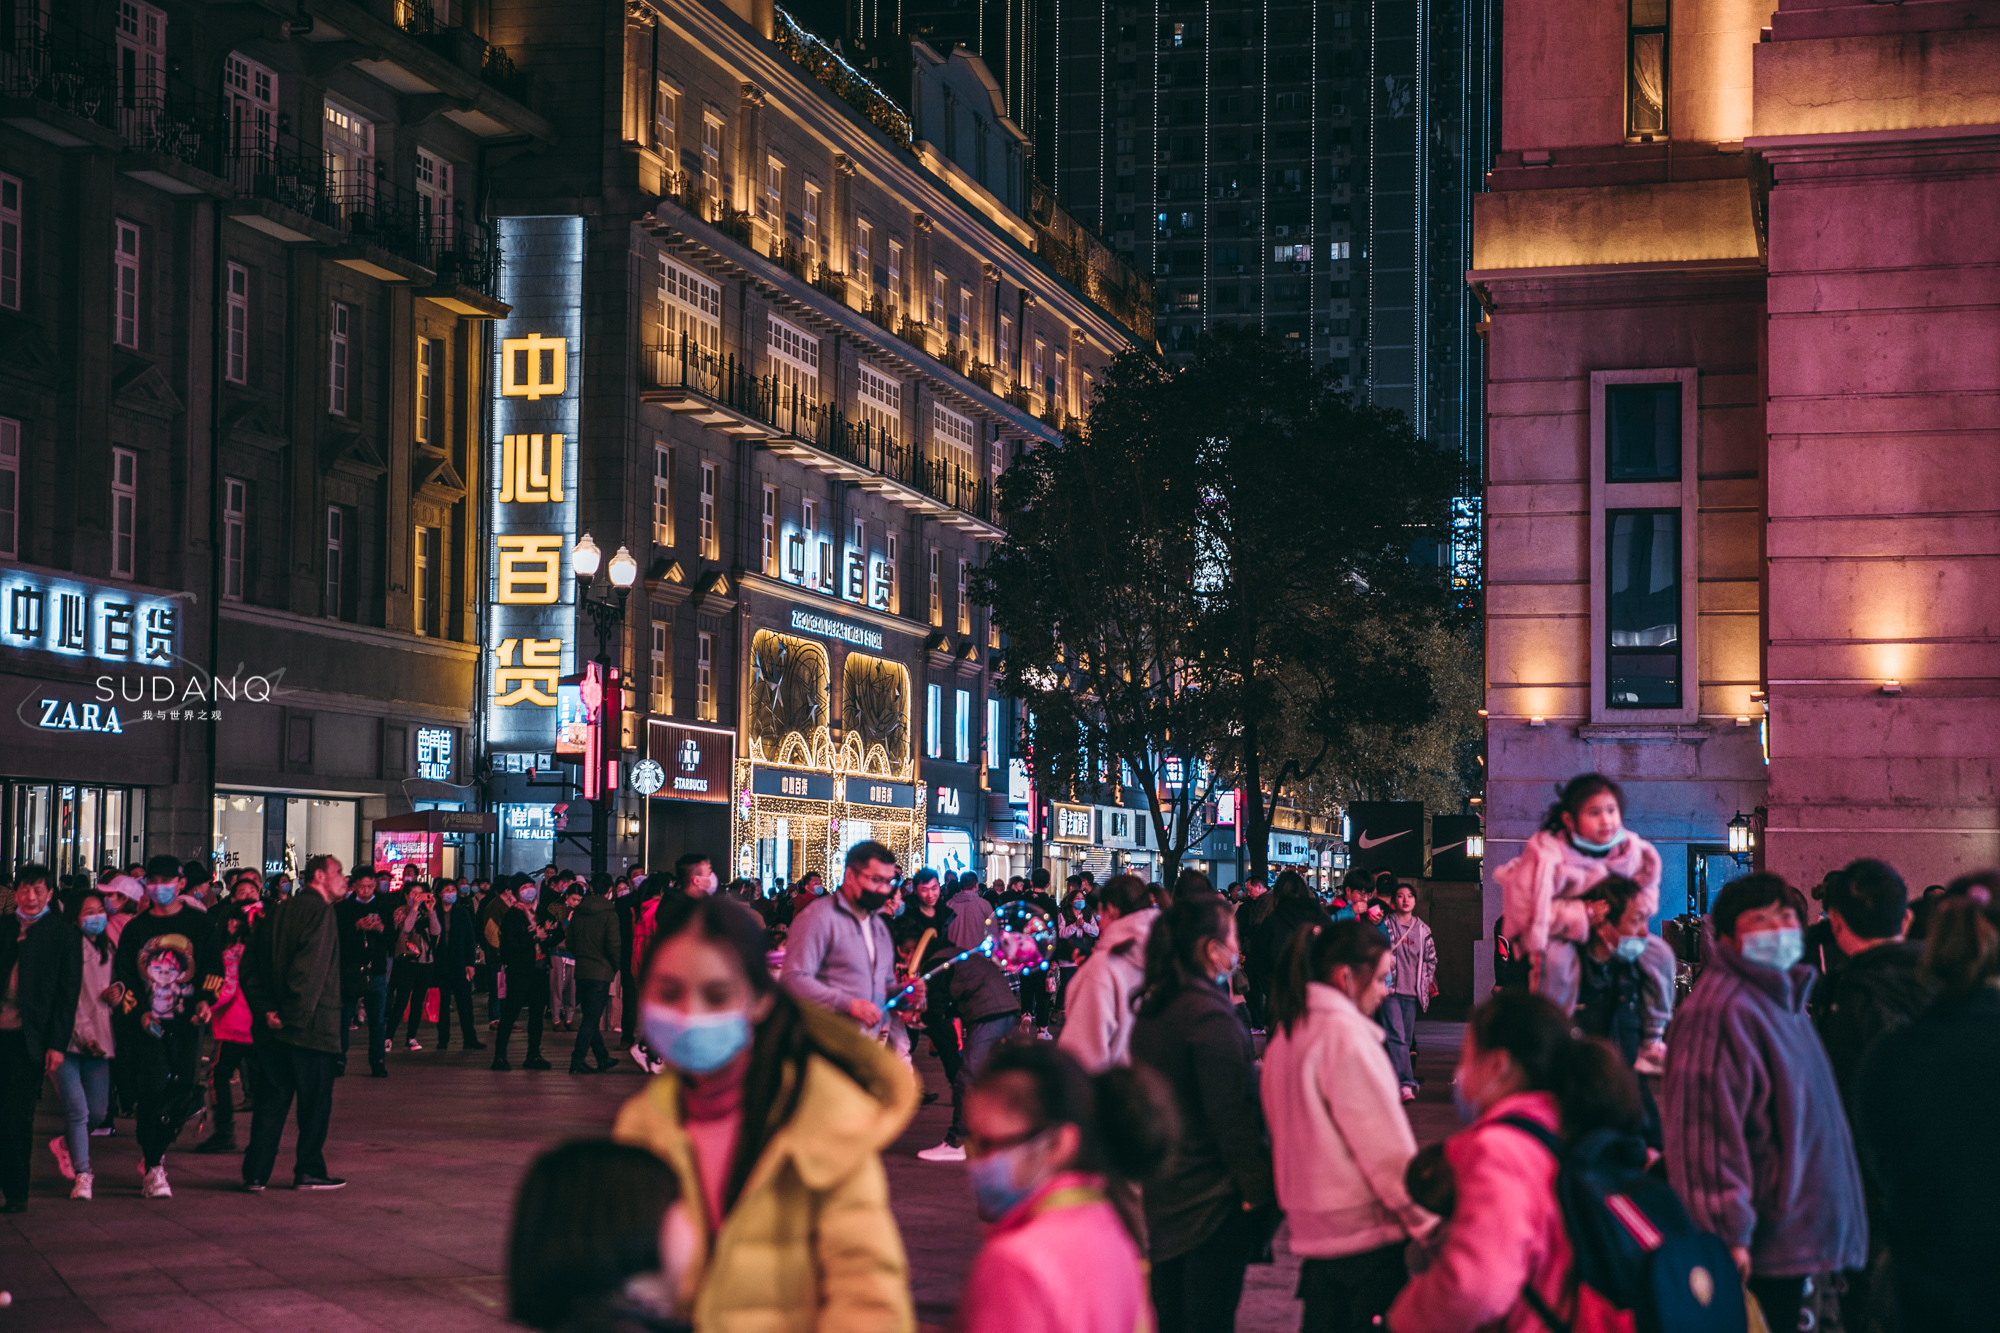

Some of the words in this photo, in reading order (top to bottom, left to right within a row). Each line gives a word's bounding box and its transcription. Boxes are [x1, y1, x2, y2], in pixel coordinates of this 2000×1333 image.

[494, 332, 568, 707] 中心百货
[789, 533, 893, 607] 中心百货
[10, 586, 176, 662] 中心百货
[39, 698, 123, 733] ZARA
[420, 763, 431, 779] THE
[431, 763, 448, 780] ALLEY
[674, 776, 708, 792] STARBUCKS
[782, 776, 808, 795] 中心百货
[937, 786, 960, 815] FILA
[515, 829, 531, 839] THE
[531, 829, 555, 839] ALLEY
